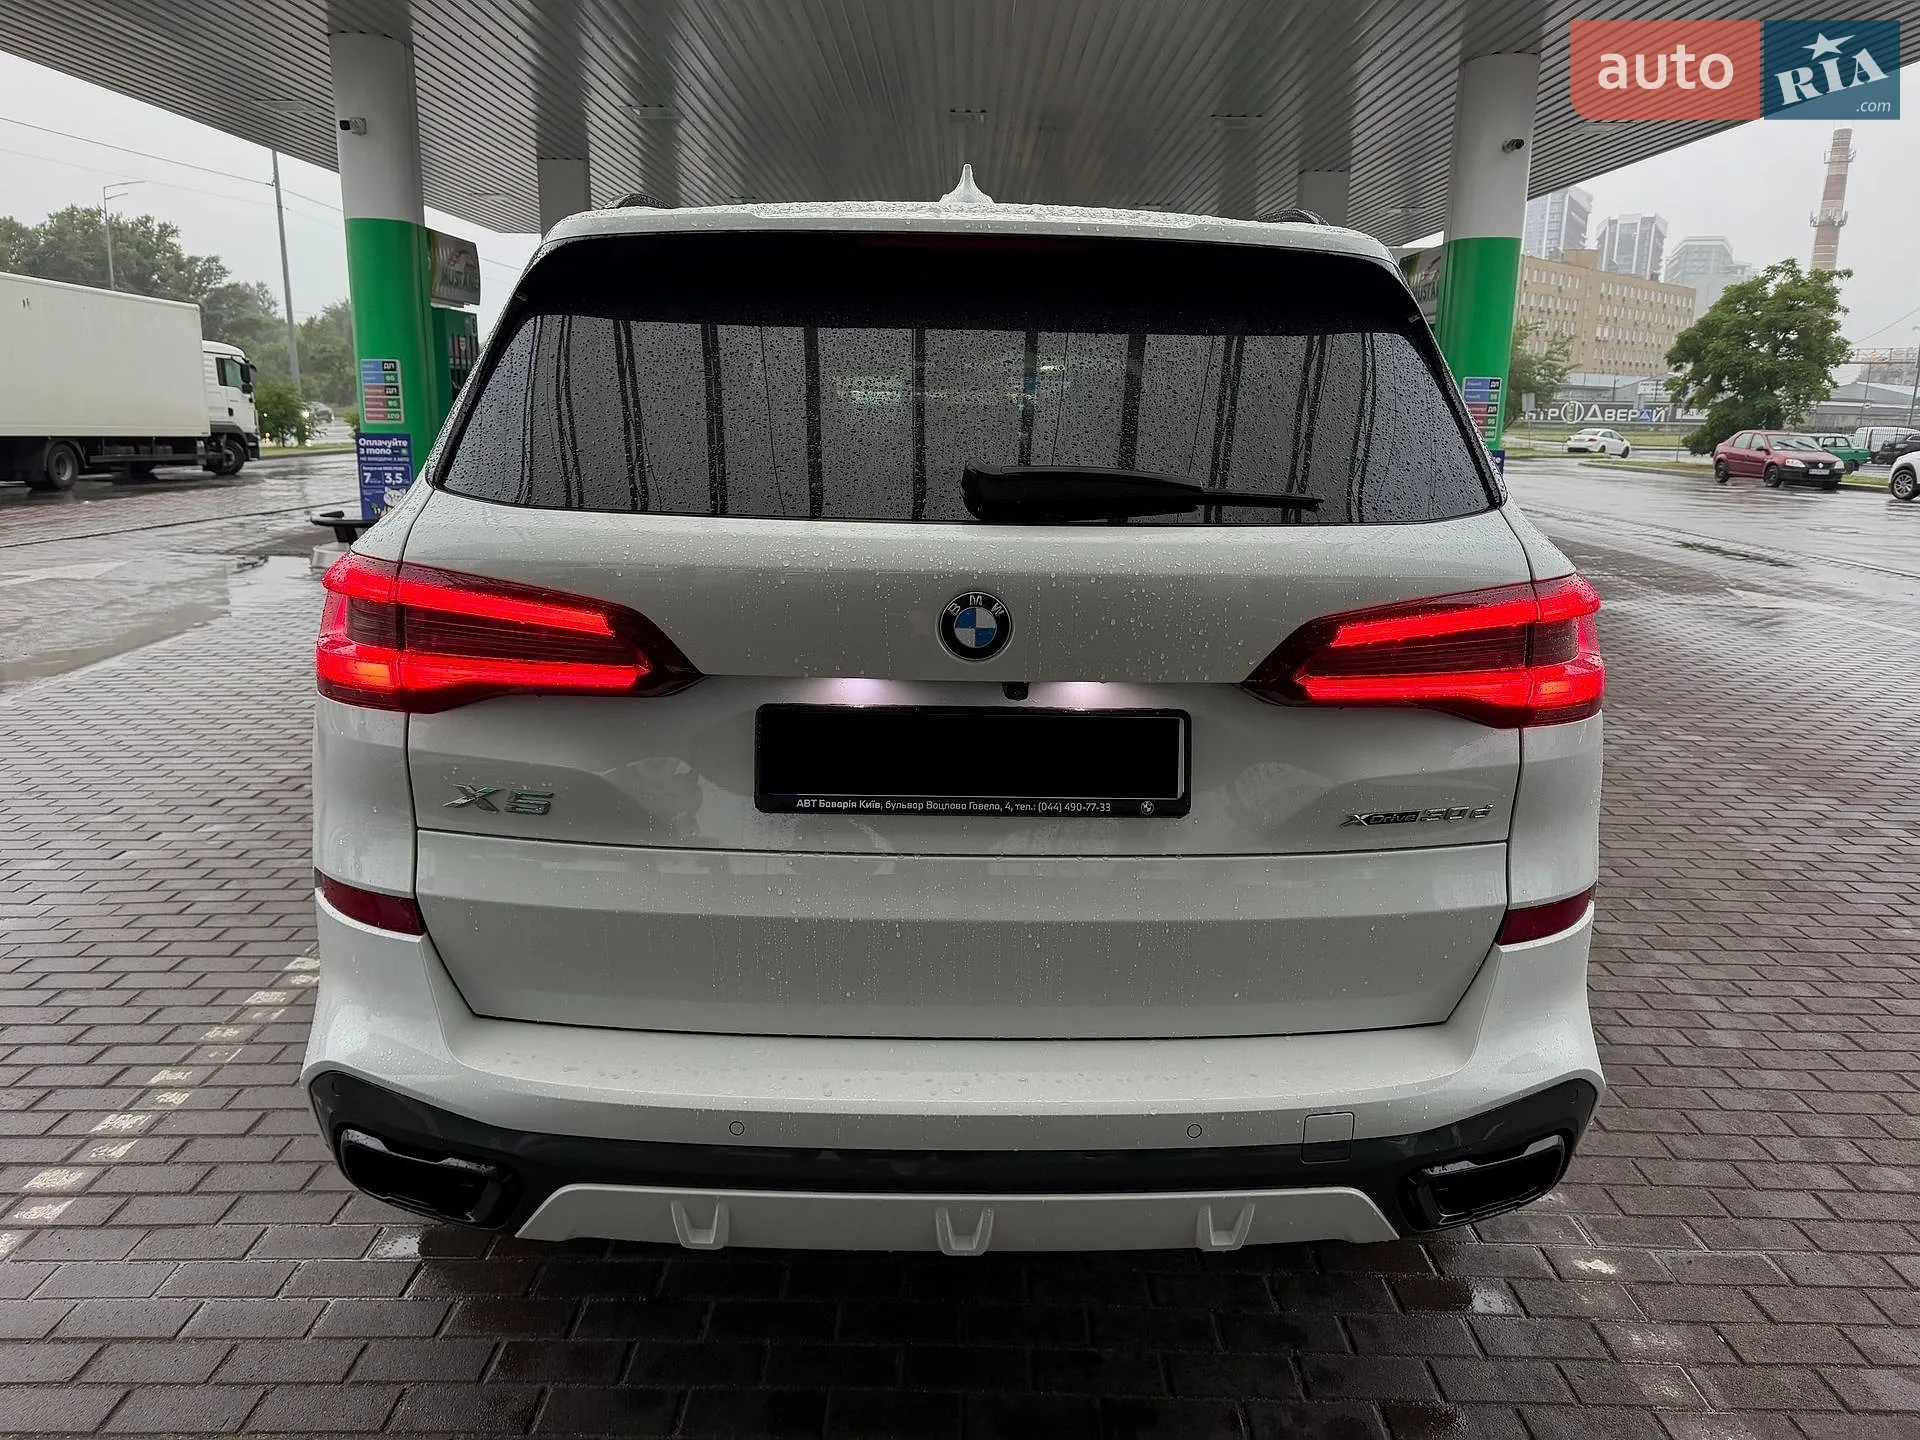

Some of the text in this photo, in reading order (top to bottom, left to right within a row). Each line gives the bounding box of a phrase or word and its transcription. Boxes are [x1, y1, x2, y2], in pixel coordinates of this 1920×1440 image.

[358, 437, 408, 448] Оплачуйте
[363, 472, 372, 484] 7
[384, 472, 403, 485] 3,5
[947, 594, 1006, 617] BMW
[441, 783, 555, 816] X5
[796, 799, 1111, 813] АВТ Баварія Київ, бульвар Вацлава Гавела, 4, тел.: (044) 490-77-33
